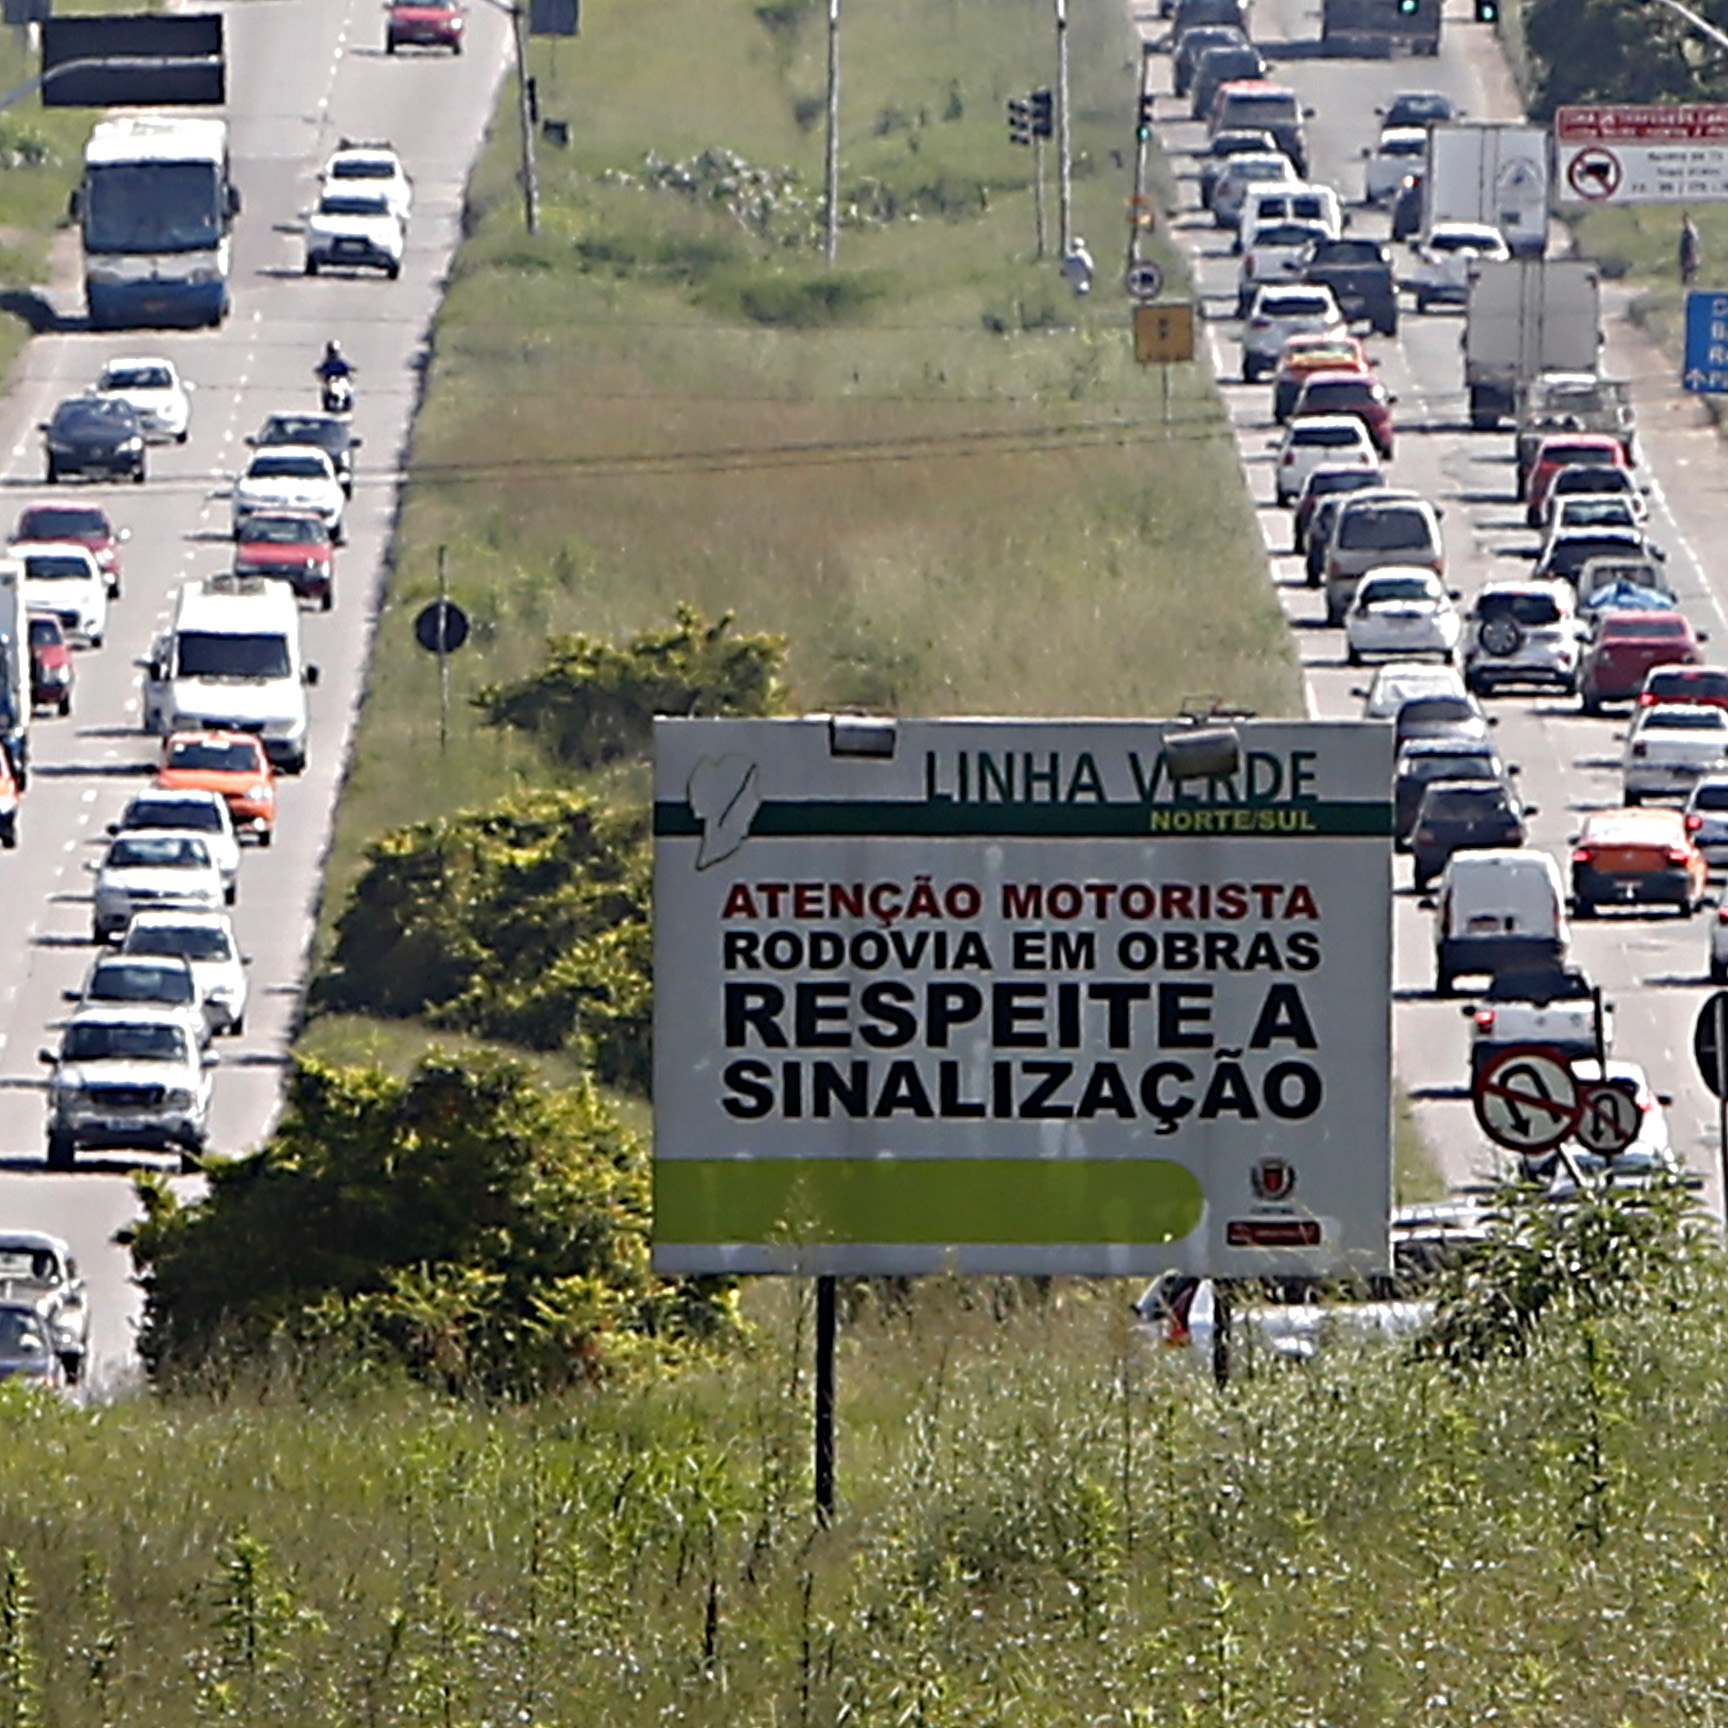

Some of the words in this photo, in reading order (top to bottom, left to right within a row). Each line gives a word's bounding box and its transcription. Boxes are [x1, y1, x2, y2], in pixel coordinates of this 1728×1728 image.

[927, 751, 1106, 803] LINHA
[1150, 809, 1316, 832] NORTE/SUL
[721, 875, 981, 928] ATENÇÃO
[1002, 883, 1320, 920] MOTORISTA
[723, 930, 992, 971] RODOVIA
[1012, 932, 1096, 970] EM
[1118, 931, 1321, 971] OBRAS
[724, 981, 1214, 1048] RESPEITE
[1249, 983, 1318, 1049] A
[721, 1049, 1323, 1135] SINALIZAÇÃO
